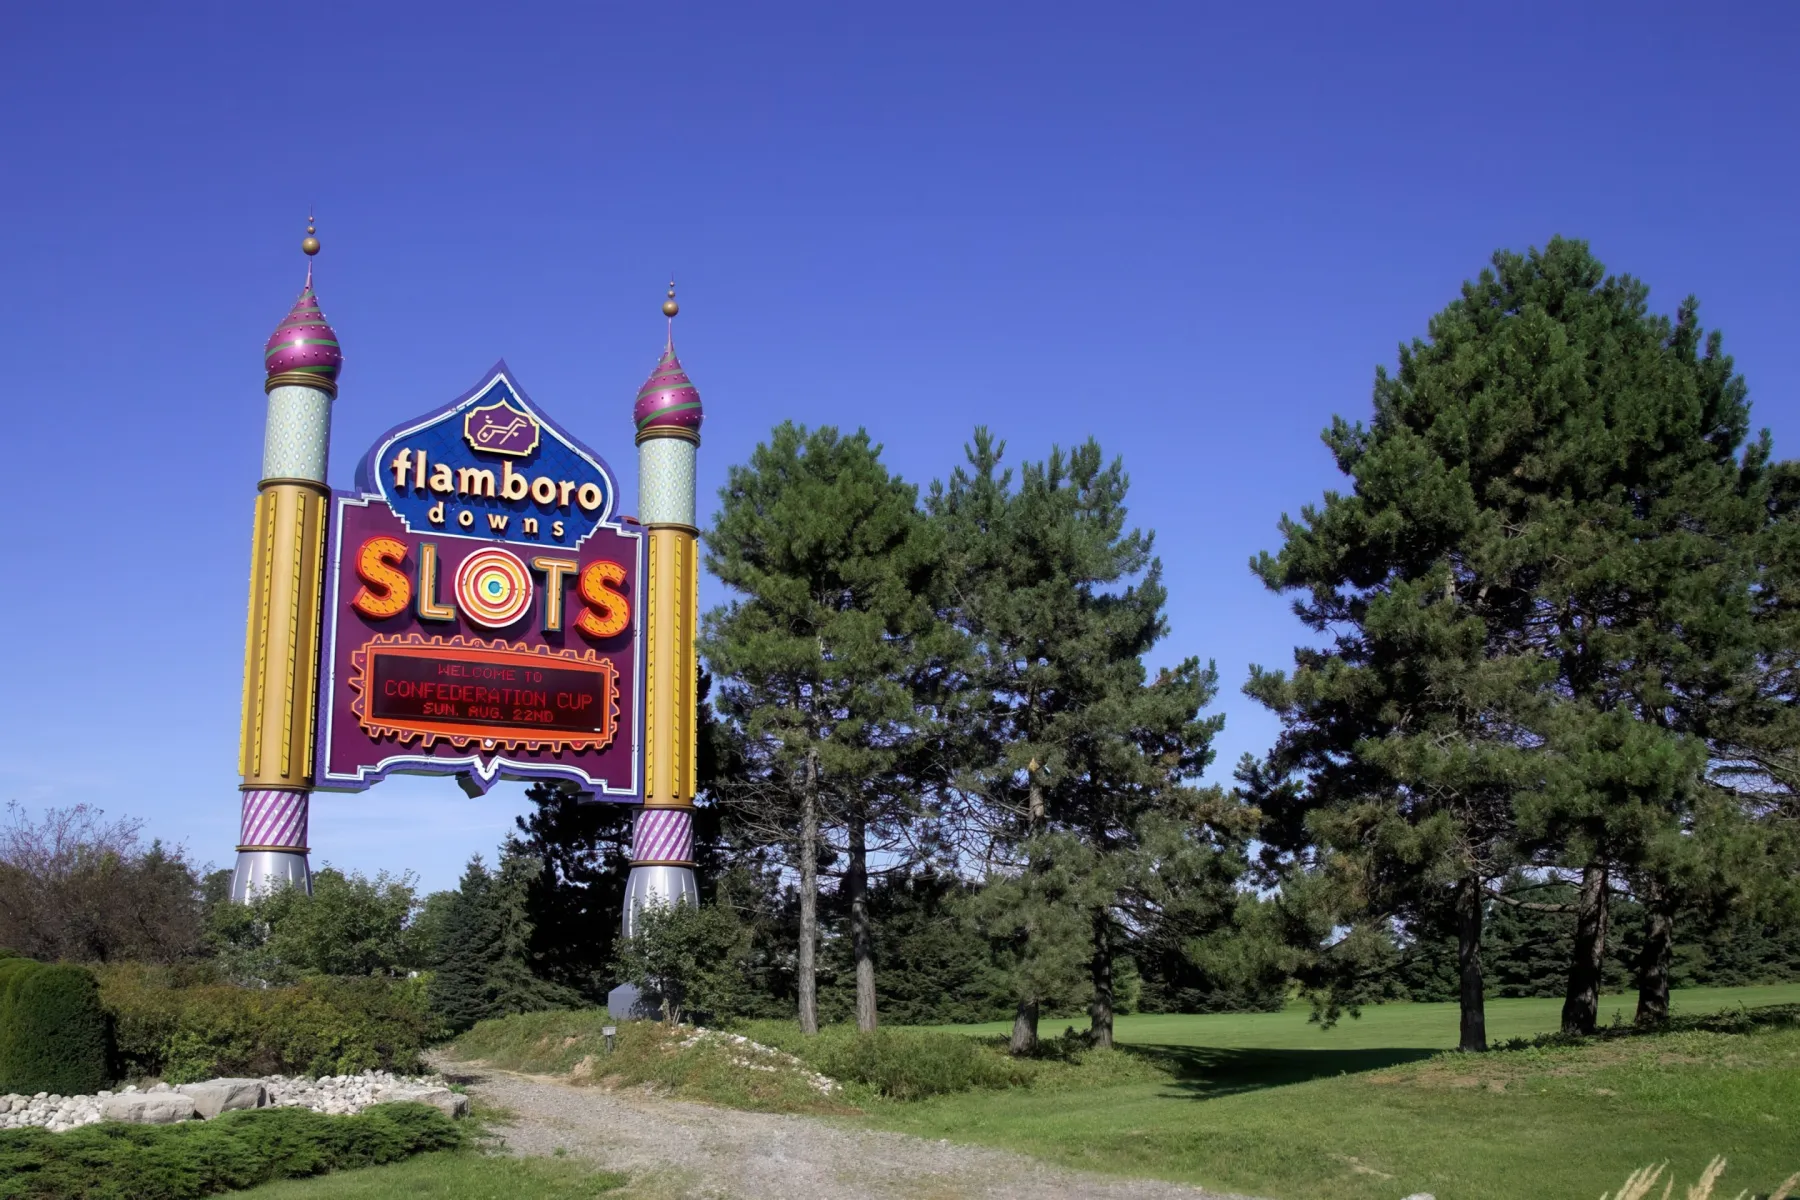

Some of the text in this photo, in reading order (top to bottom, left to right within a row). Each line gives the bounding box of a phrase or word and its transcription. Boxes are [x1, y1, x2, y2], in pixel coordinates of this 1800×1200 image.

[390, 447, 602, 511] flamboro
[428, 501, 565, 537] downs
[350, 536, 631, 638] SLOTS
[437, 664, 542, 683] WELCOME TO
[384, 679, 593, 710] CONFEDERATION CUP
[423, 702, 554, 723] SUN. AUG. 22ND
